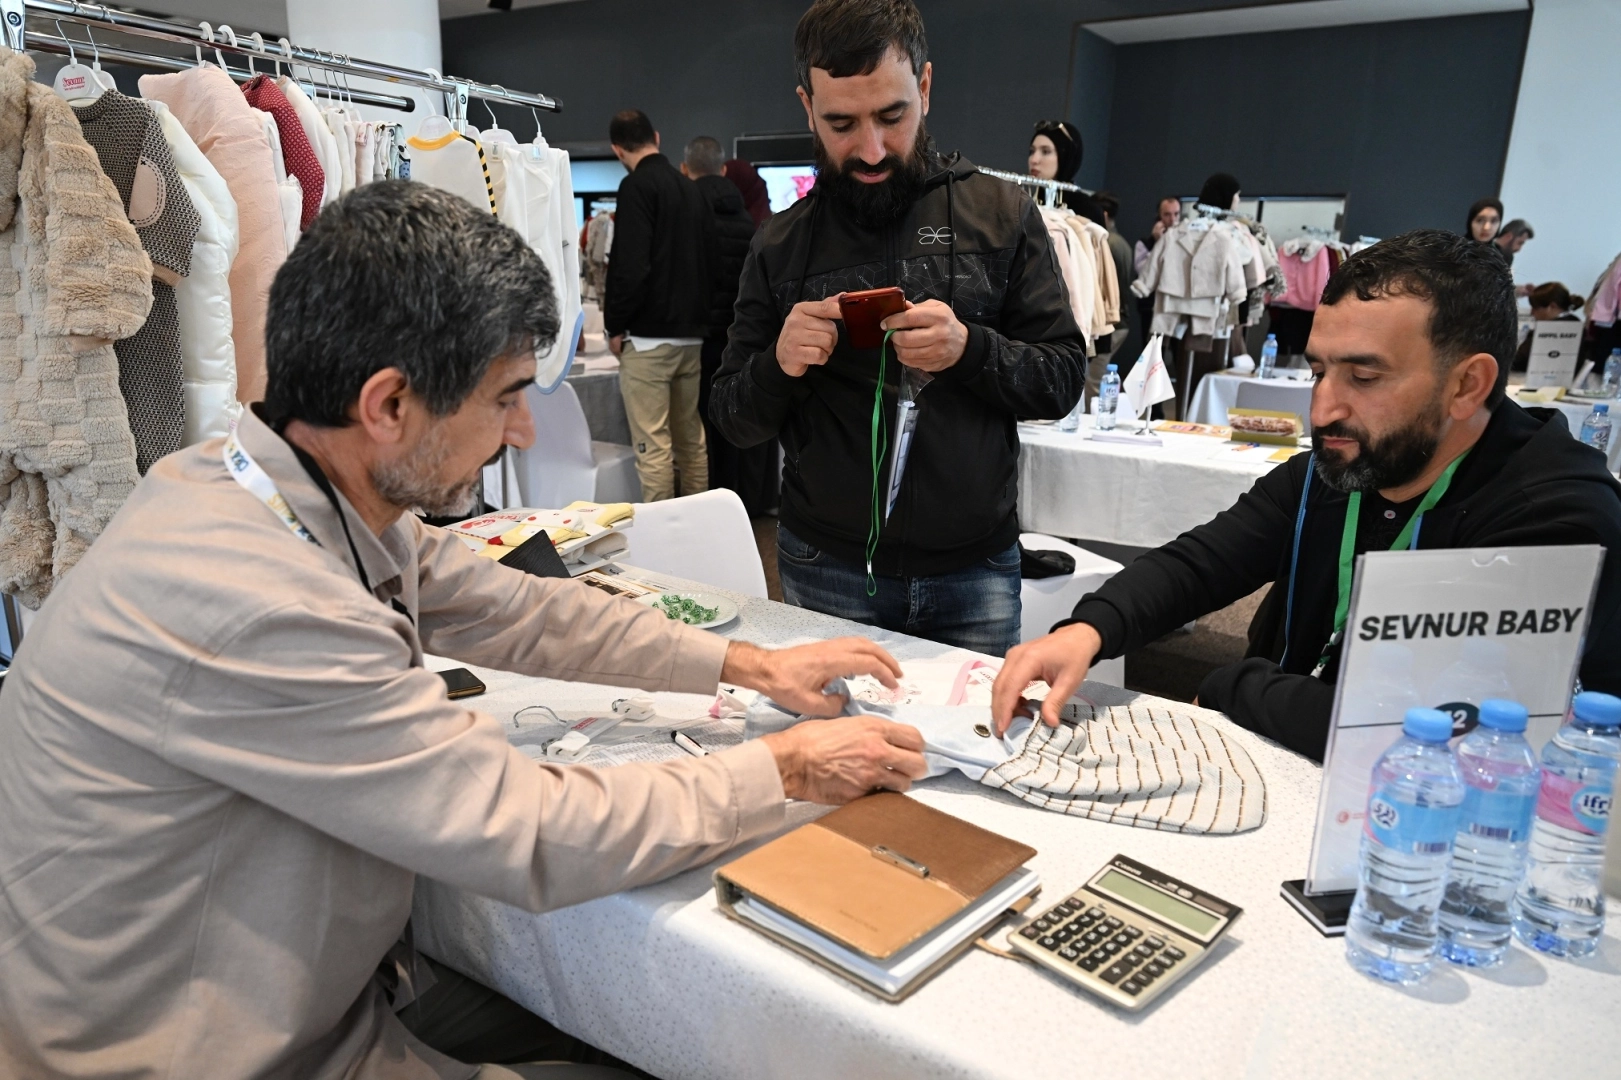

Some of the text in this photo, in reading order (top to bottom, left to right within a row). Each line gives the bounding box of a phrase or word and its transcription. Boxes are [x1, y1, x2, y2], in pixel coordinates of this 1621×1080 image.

[1358, 607, 1584, 641] SEVNUR BABY
[1114, 860, 1142, 876] Canon
